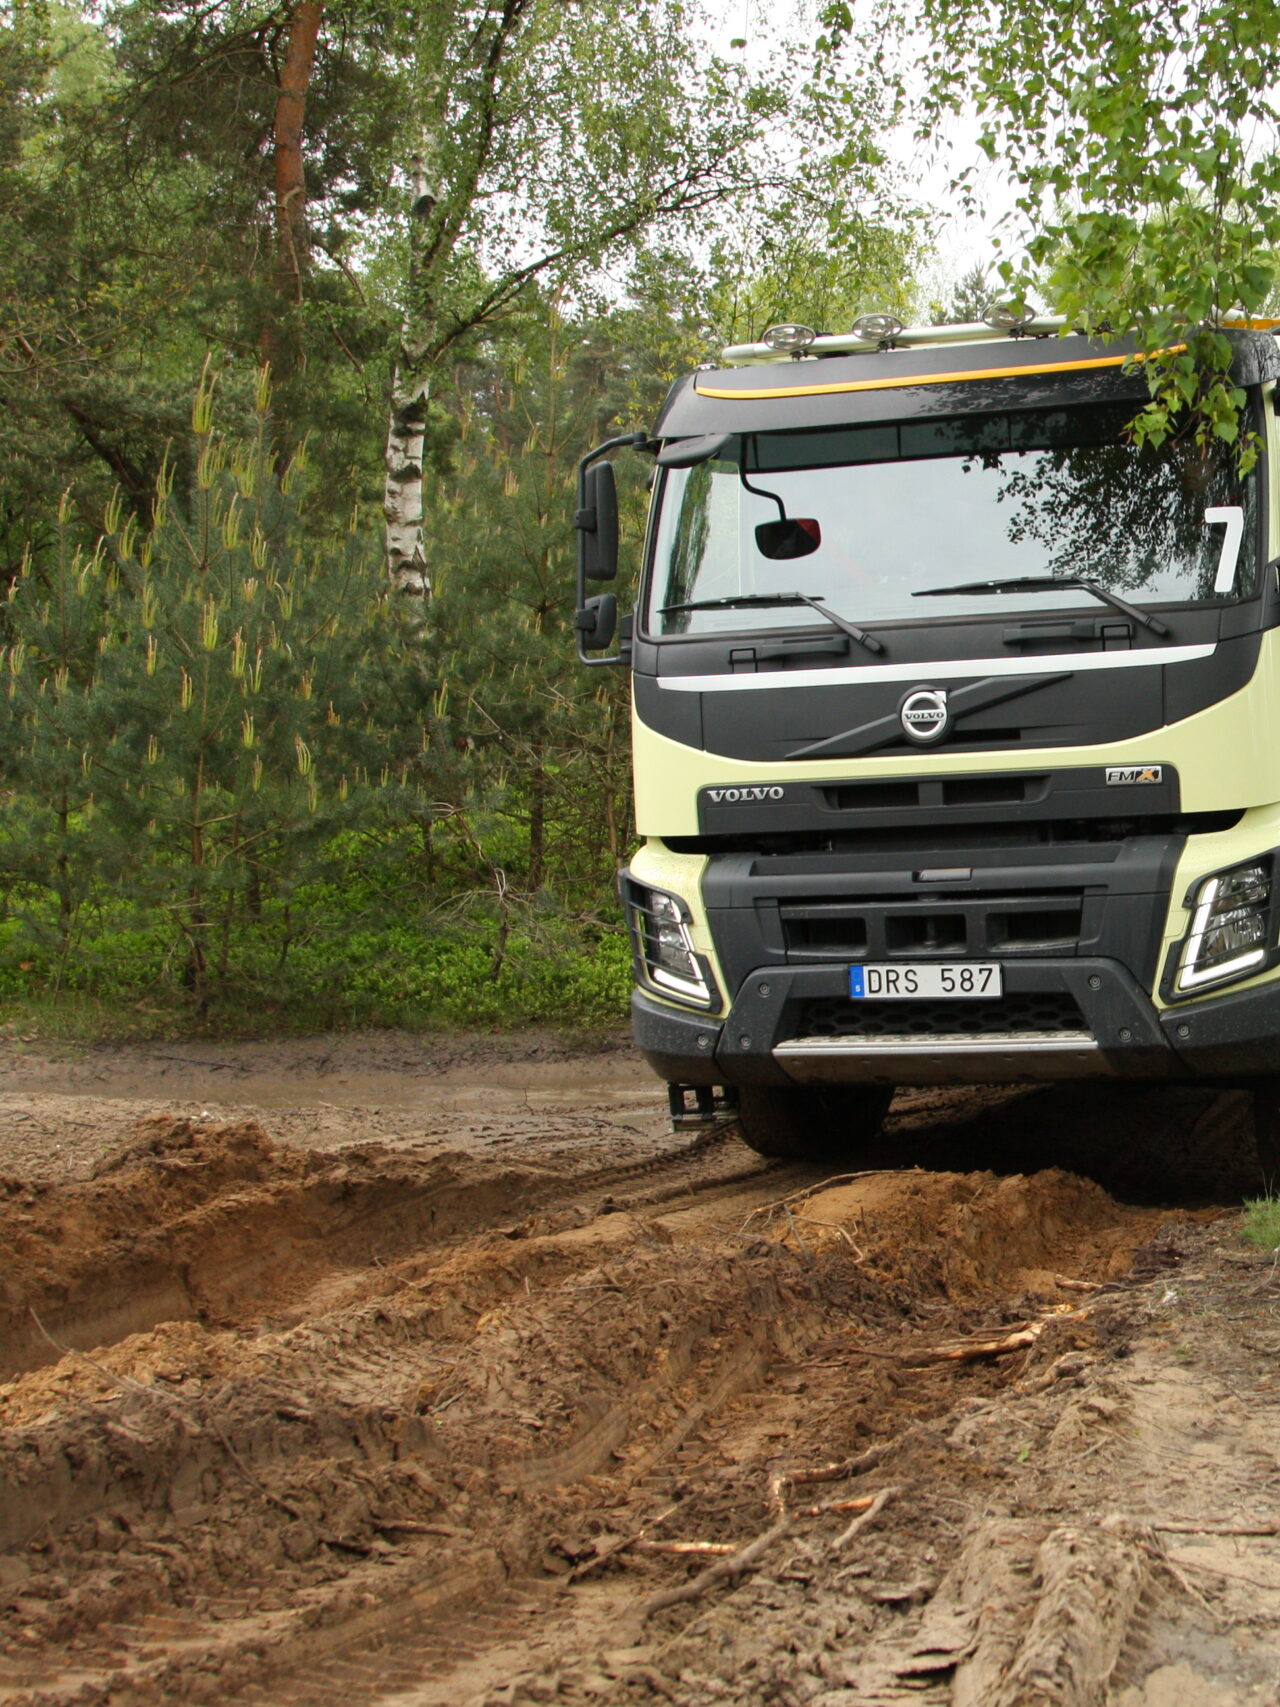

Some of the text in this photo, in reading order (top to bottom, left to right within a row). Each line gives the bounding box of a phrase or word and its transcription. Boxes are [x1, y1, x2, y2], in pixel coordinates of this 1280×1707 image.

[1204, 506, 1244, 593] 7
[904, 711, 945, 720] VOLVO
[706, 786, 785, 803] VOLVO
[867, 968, 919, 994] DRS
[940, 967, 994, 993] 587
